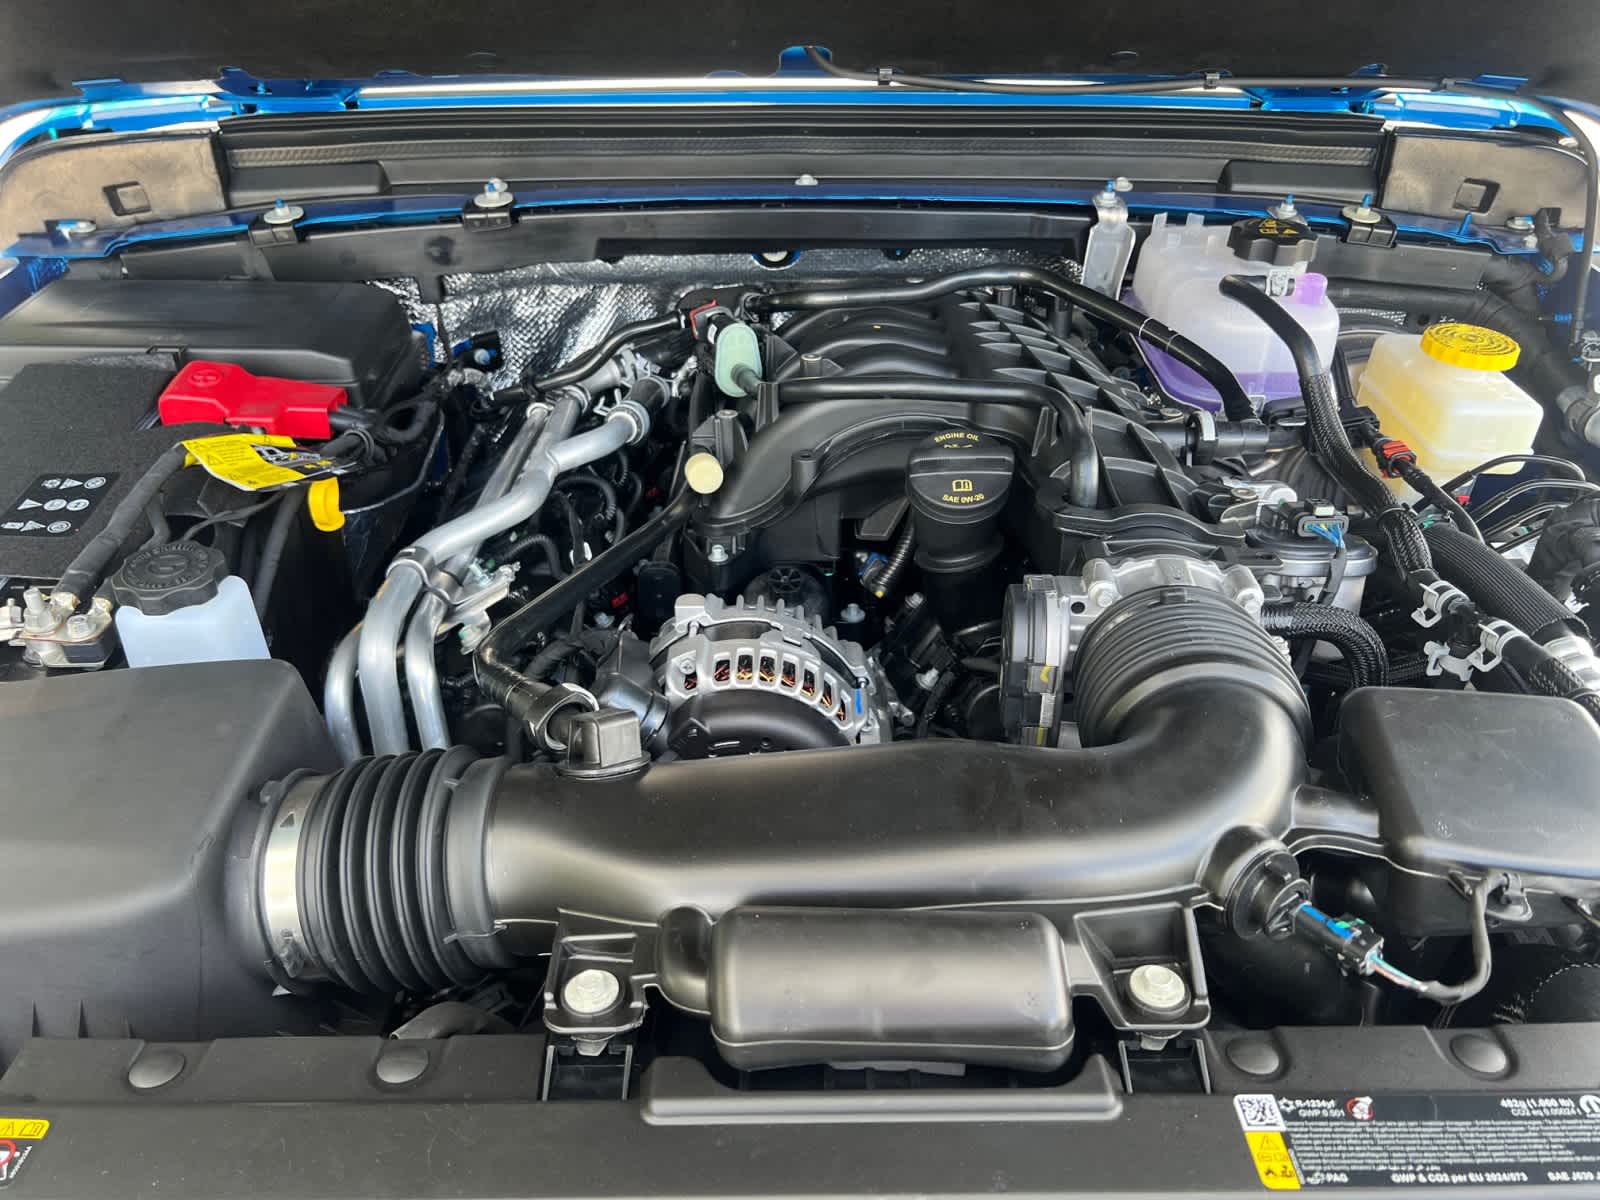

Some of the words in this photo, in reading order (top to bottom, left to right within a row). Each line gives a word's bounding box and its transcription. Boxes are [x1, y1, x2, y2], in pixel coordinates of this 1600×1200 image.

[934, 432, 965, 442] ENGINE
[966, 433, 980, 441] OIL
[942, 494, 960, 503] SAE
[1298, 1109, 1321, 1118] GWP
[1325, 1172, 1349, 1183] PAG
[1391, 1172, 1416, 1183] GWP
[1427, 1172, 1450, 1182] CO2
[1451, 1173, 1467, 1184] per
[1468, 1172, 1484, 1182] EU
[1547, 1171, 1570, 1181] SAE
